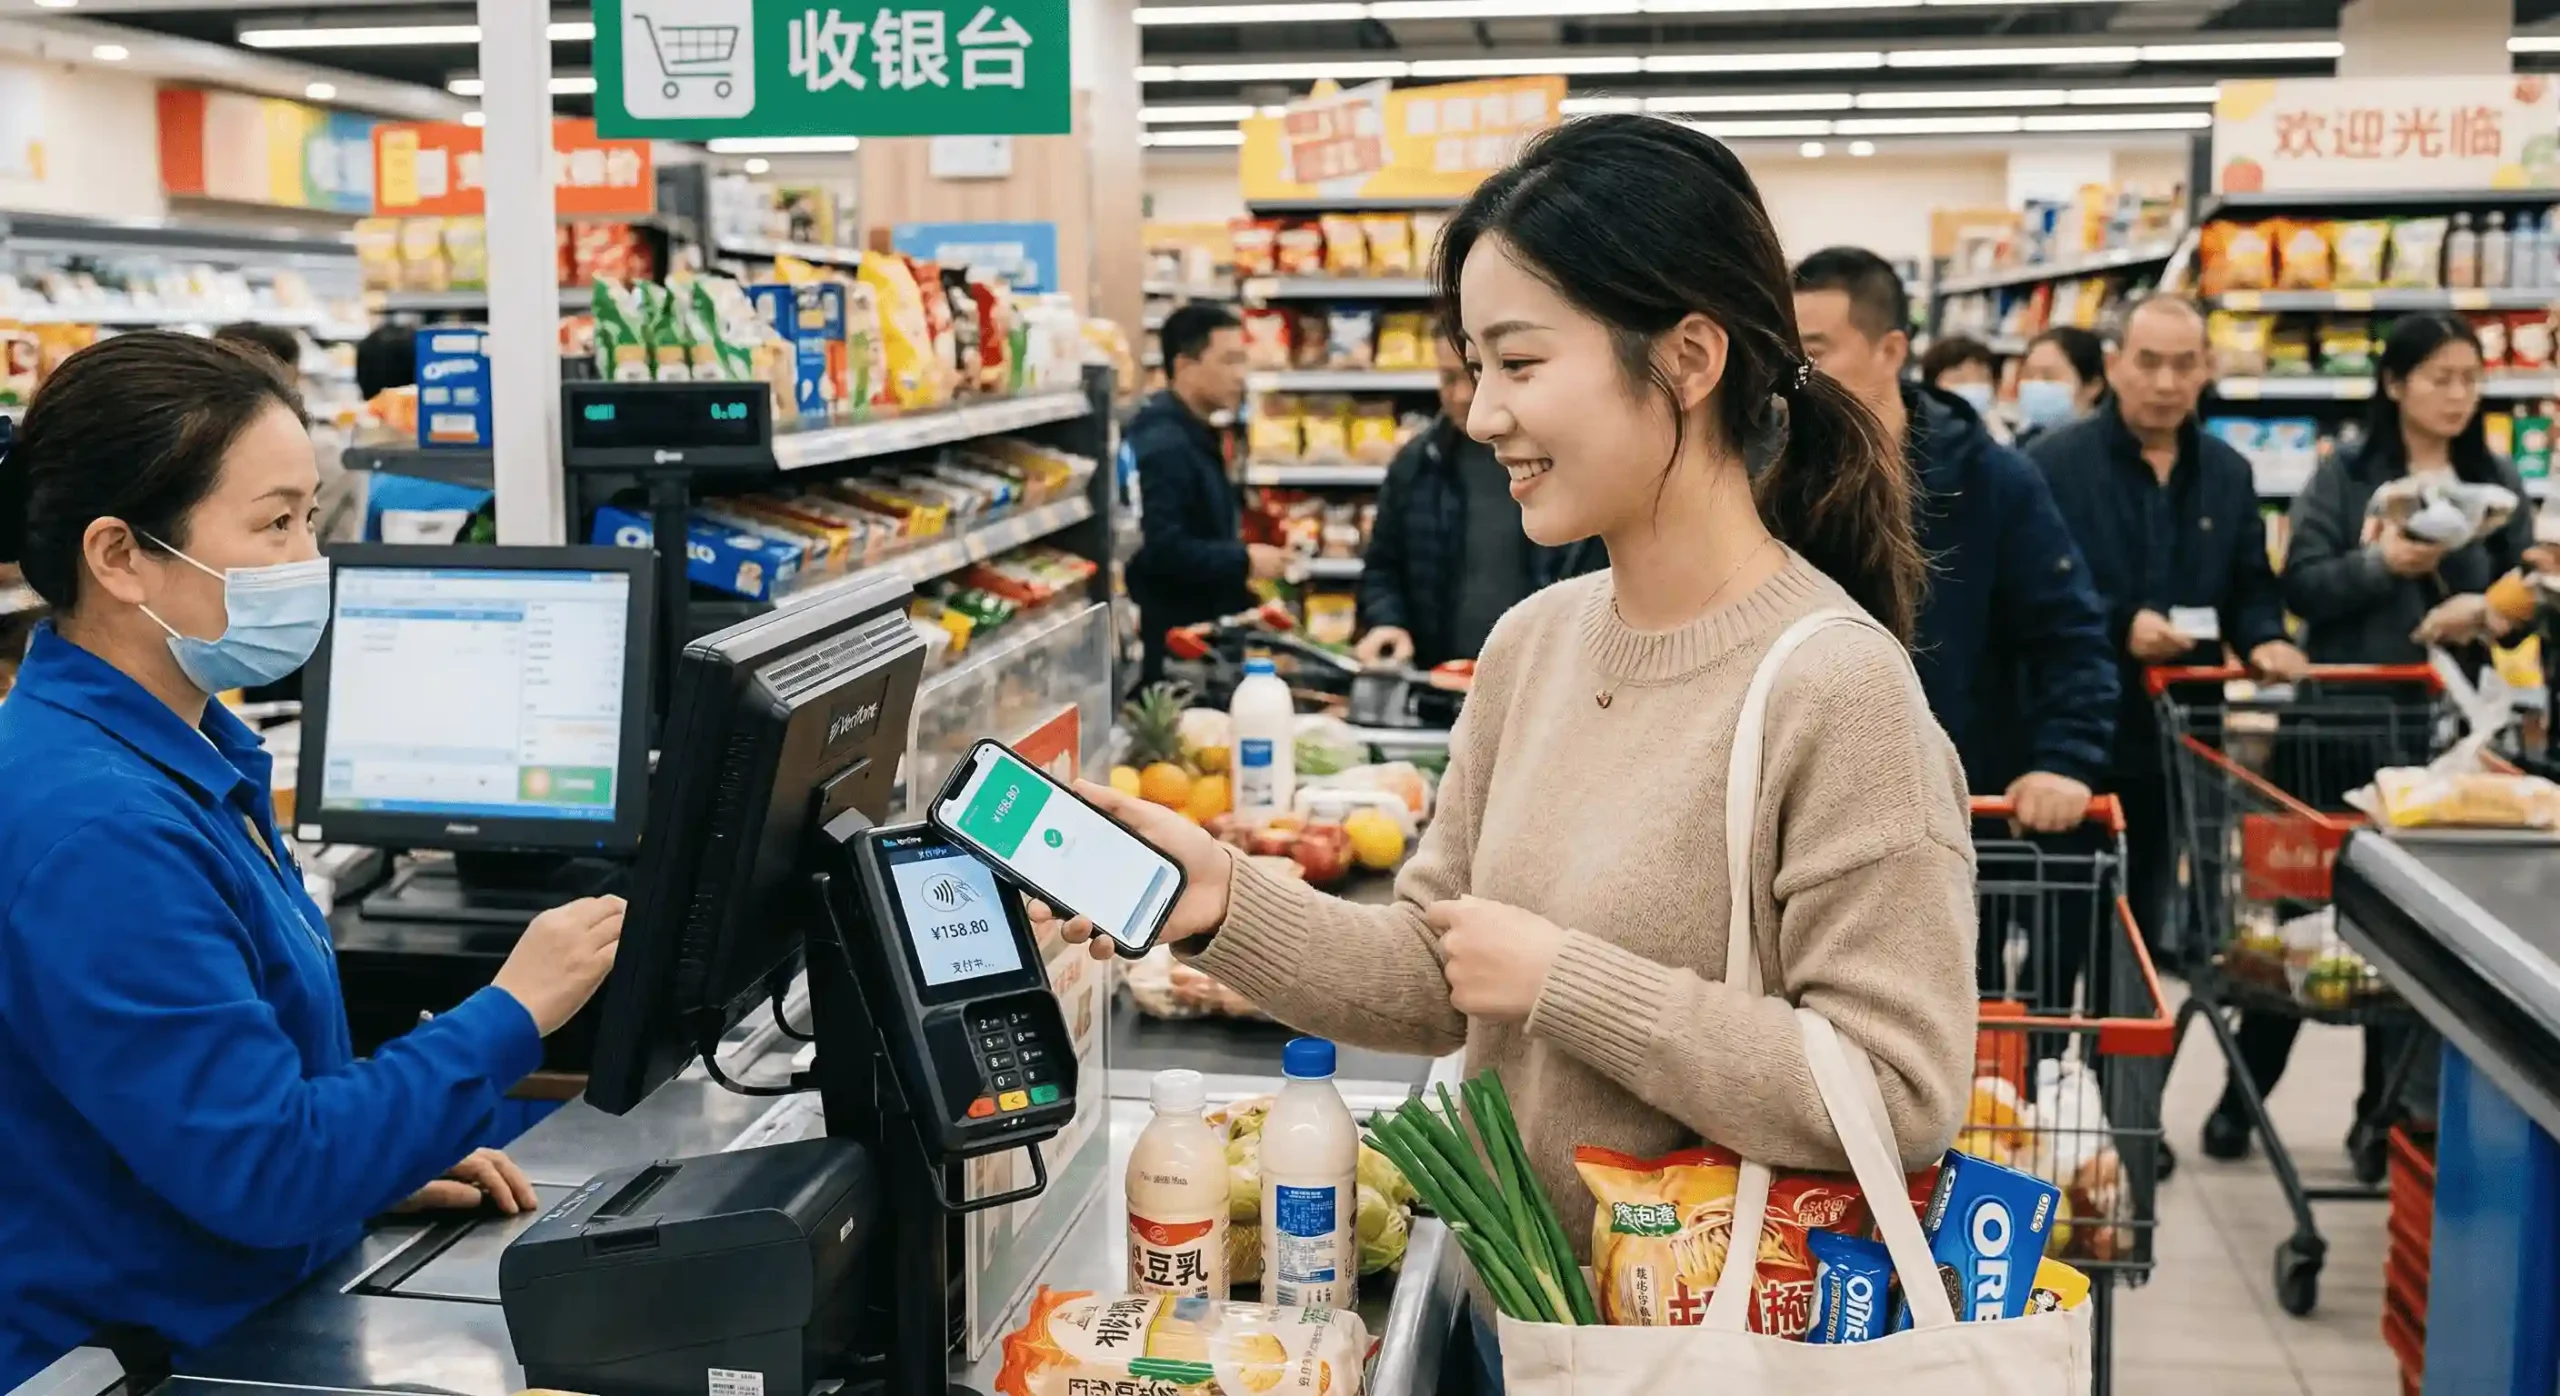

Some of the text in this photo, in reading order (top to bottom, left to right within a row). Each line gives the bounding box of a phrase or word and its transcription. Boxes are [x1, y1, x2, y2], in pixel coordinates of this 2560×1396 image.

[787, 6, 1034, 91] 收银台
[2273, 105, 2503, 160] 欢迎光临
[990, 783, 1021, 825] ¥158.80
[931, 919, 989, 941] ¥158.80
[980, 1019, 988, 1030] 2
[1017, 1032, 1025, 1042] 6
[991, 1057, 999, 1067] 8
[1023, 1051, 1030, 1061] 9
[997, 1076, 1005, 1086] 0
[1144, 1248, 1208, 1287] 豆乳
